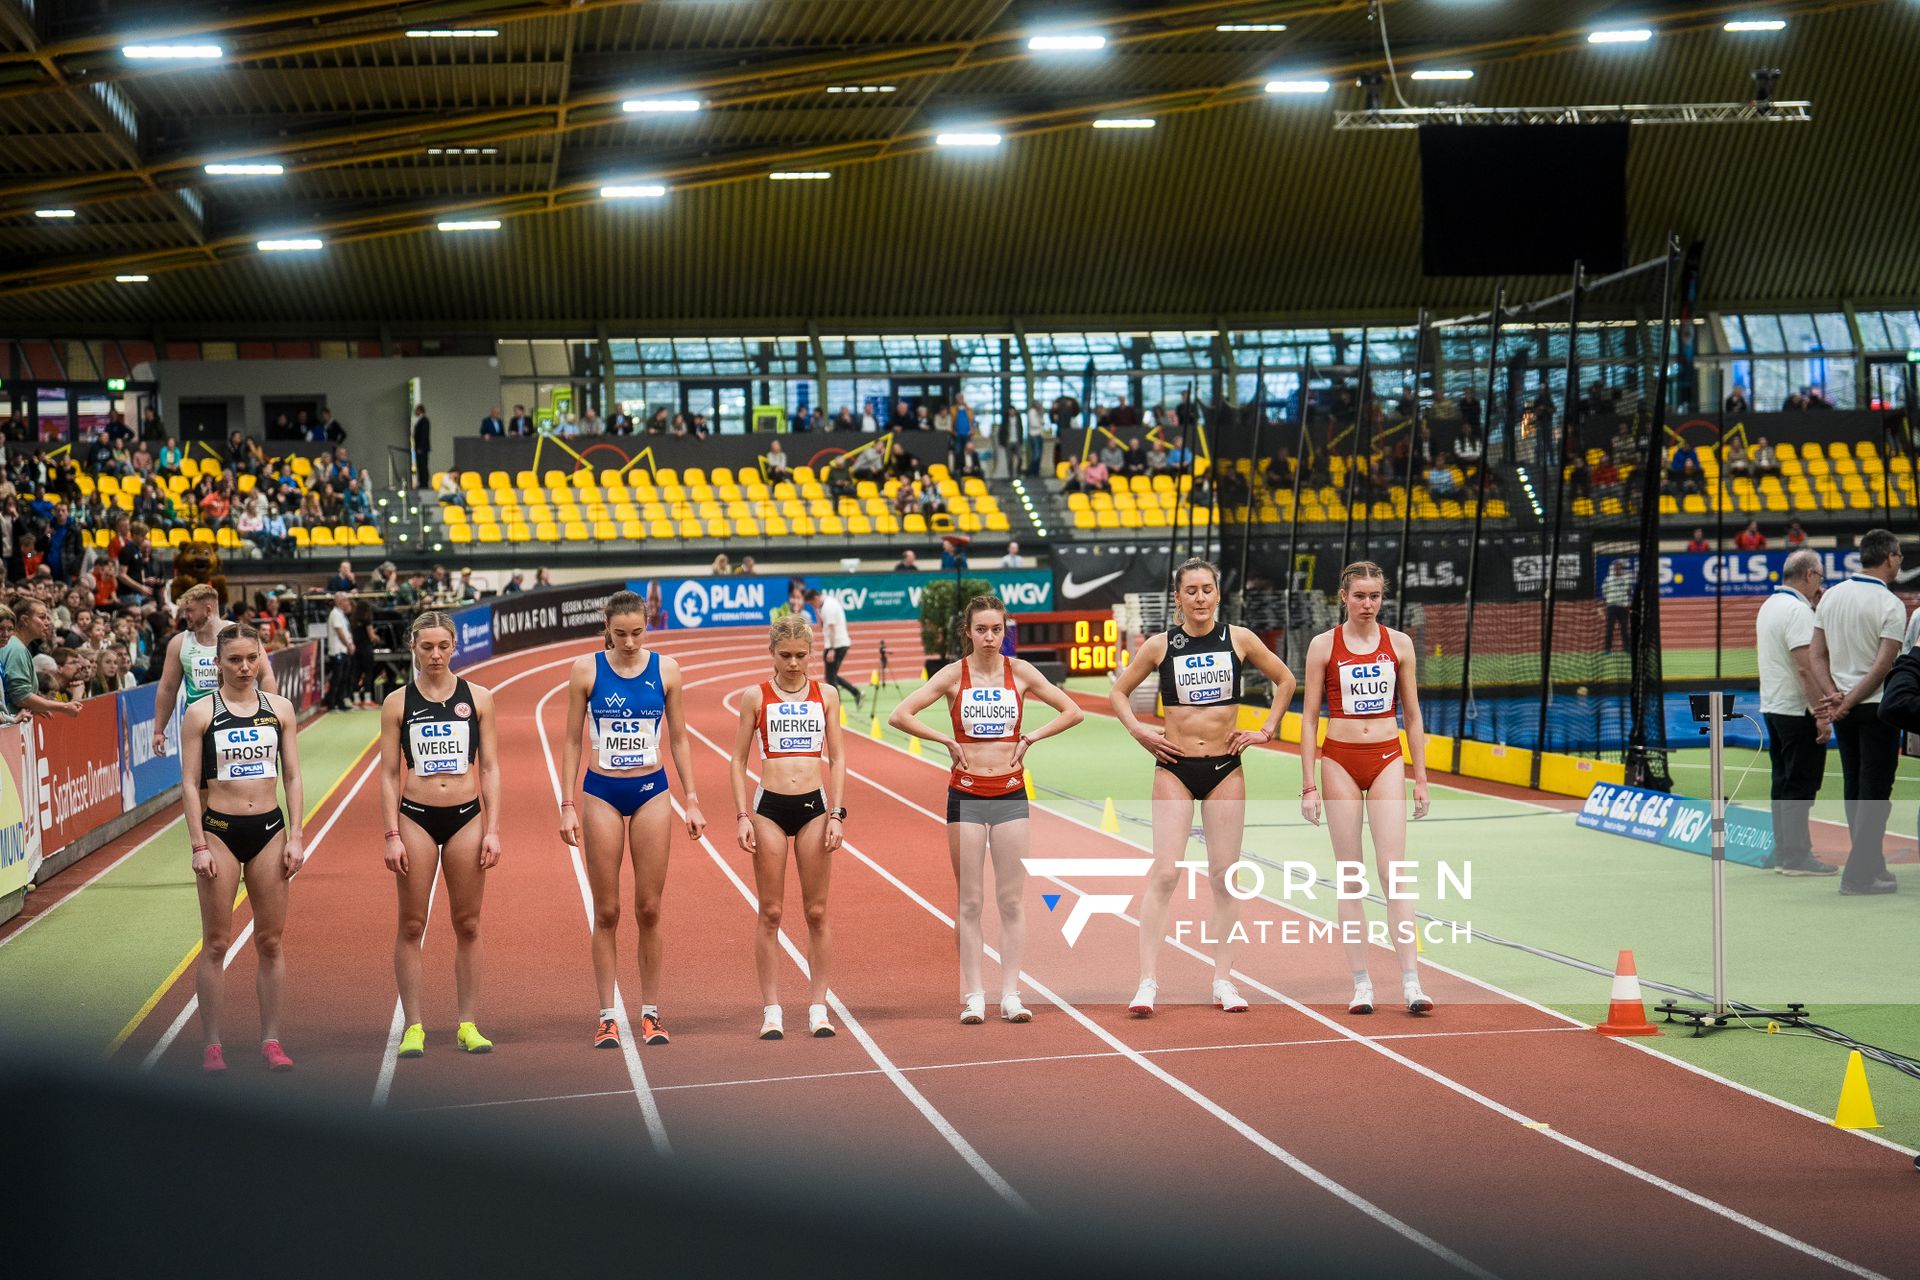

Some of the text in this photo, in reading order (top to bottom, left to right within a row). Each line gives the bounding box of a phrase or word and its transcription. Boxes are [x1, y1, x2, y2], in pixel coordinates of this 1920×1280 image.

[1703, 554, 1778, 583] GLS.
[710, 584, 764, 609] PLAN
[999, 582, 1051, 605] WGV
[500, 607, 557, 635] NOVAFON
[1178, 670, 1231, 686] UDELHOVEN
[1350, 681, 1388, 695] KLUG
[963, 703, 1016, 719] SCHLÜSCHE
[770, 719, 822, 733] MERKEL
[222, 745, 273, 760] TROST
[606, 737, 649, 751] MEISL
[53, 748, 121, 835] Sparkasse Dortmund
[1668, 806, 1711, 843] WGV
